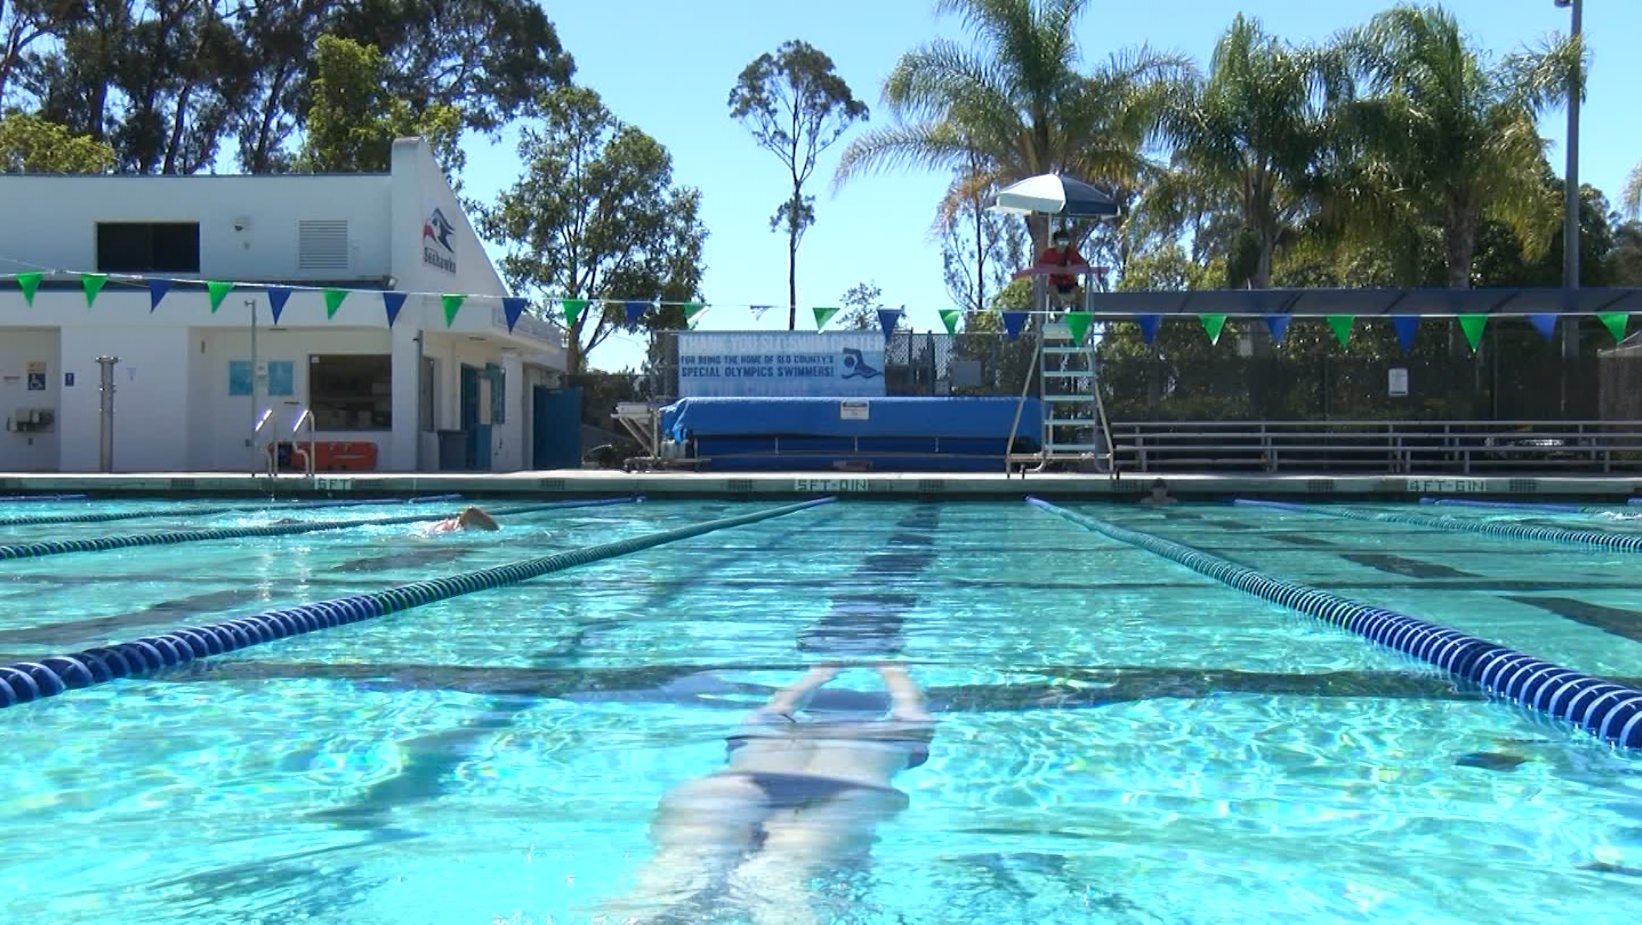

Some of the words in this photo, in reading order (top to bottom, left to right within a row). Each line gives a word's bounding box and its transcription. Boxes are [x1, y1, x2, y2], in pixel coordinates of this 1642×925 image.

[730, 334, 758, 352] YOU
[681, 355, 696, 365] FOR
[698, 355, 721, 365] BEING
[724, 355, 738, 365] THE
[740, 355, 762, 365] HOME
[764, 355, 774, 365] OF
[777, 355, 791, 364] SLO
[794, 355, 834, 364] COUNTY'S
[681, 366, 721, 377] SPECIAL
[724, 366, 774, 377] OLYMPICS
[777, 366, 834, 377] SWIMMERS!
